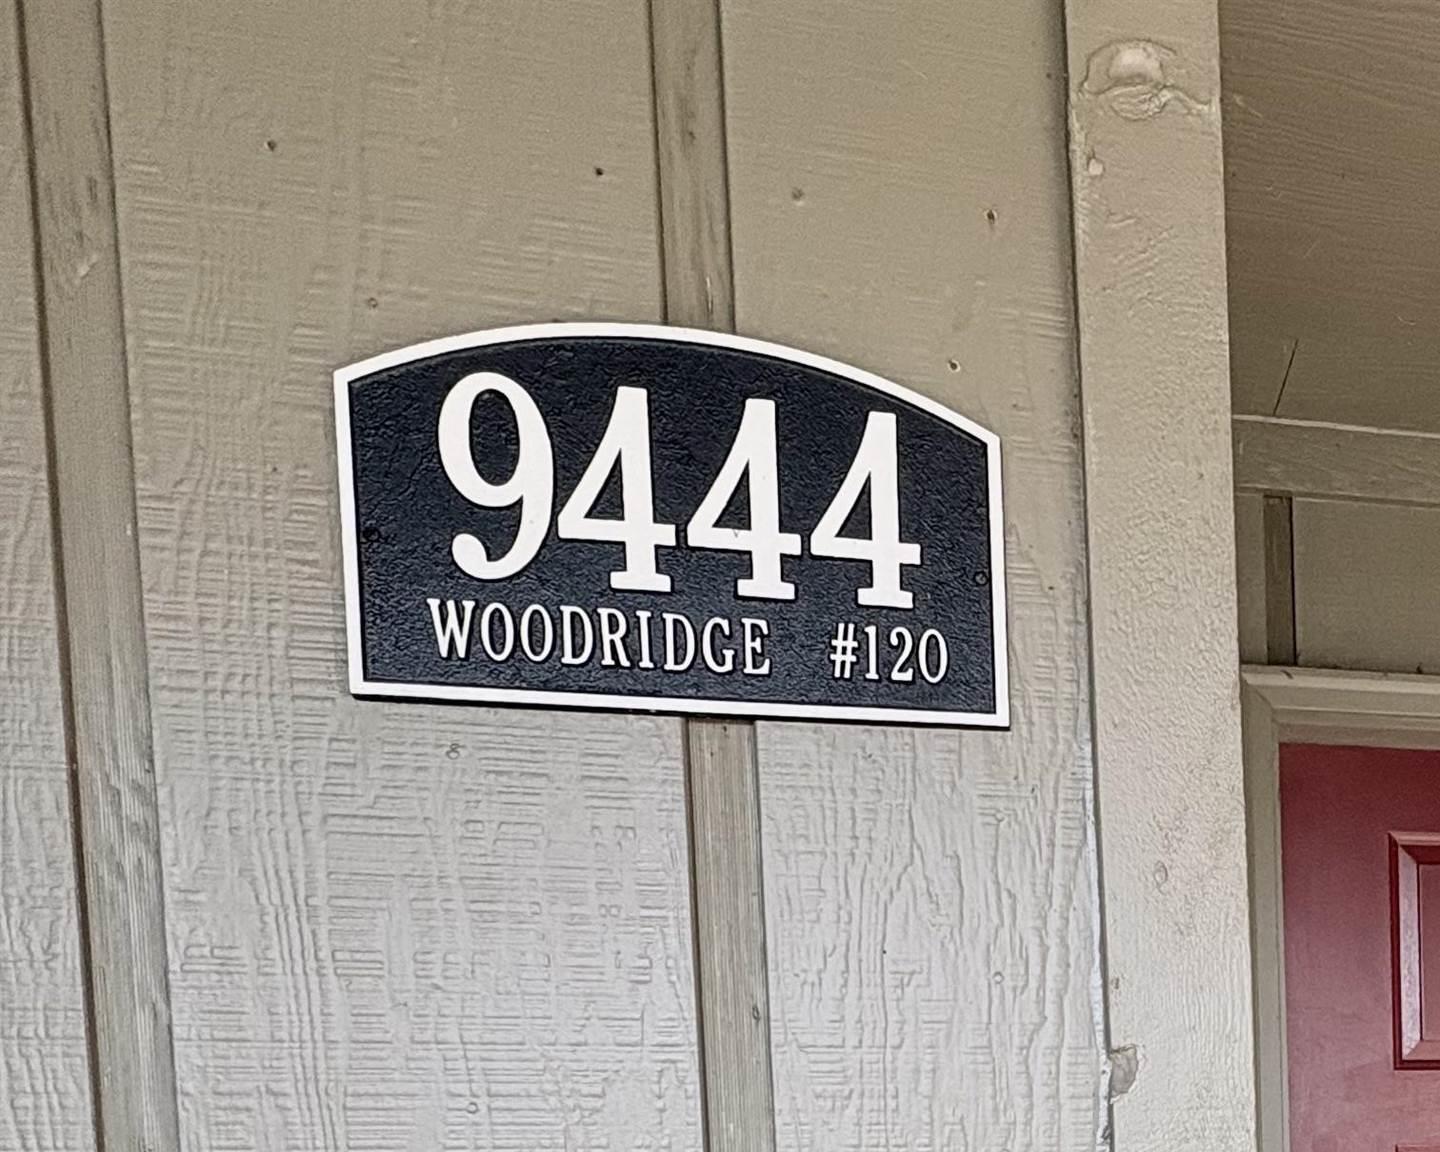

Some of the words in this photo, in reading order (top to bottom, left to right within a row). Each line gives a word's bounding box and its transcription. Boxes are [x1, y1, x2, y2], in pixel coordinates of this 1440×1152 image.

[438, 371, 921, 609] 9444
[426, 597, 770, 675] WOODRIDGE
[829, 622, 948, 684] #120
